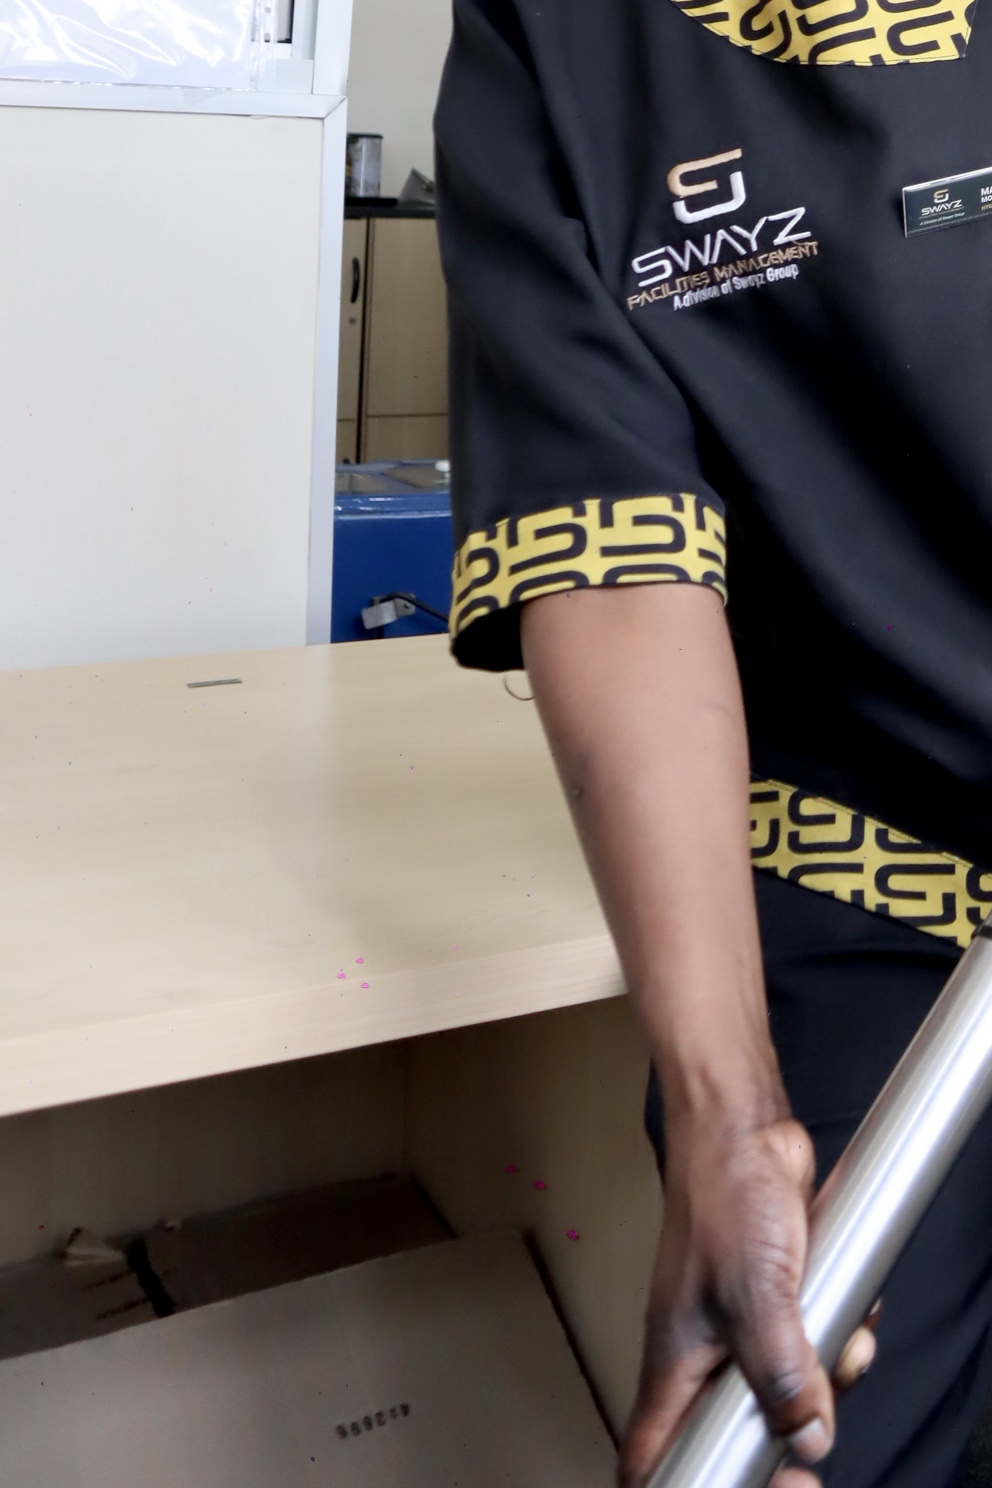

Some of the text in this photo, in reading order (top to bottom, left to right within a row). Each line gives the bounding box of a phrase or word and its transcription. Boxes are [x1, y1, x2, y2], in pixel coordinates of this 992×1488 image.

[921, 199, 963, 216] SWAYZ
[631, 206, 812, 287] SWAYZ
[627, 241, 819, 311] FACILITIES MANAGEMENT
[766, 263, 800, 283] Group
